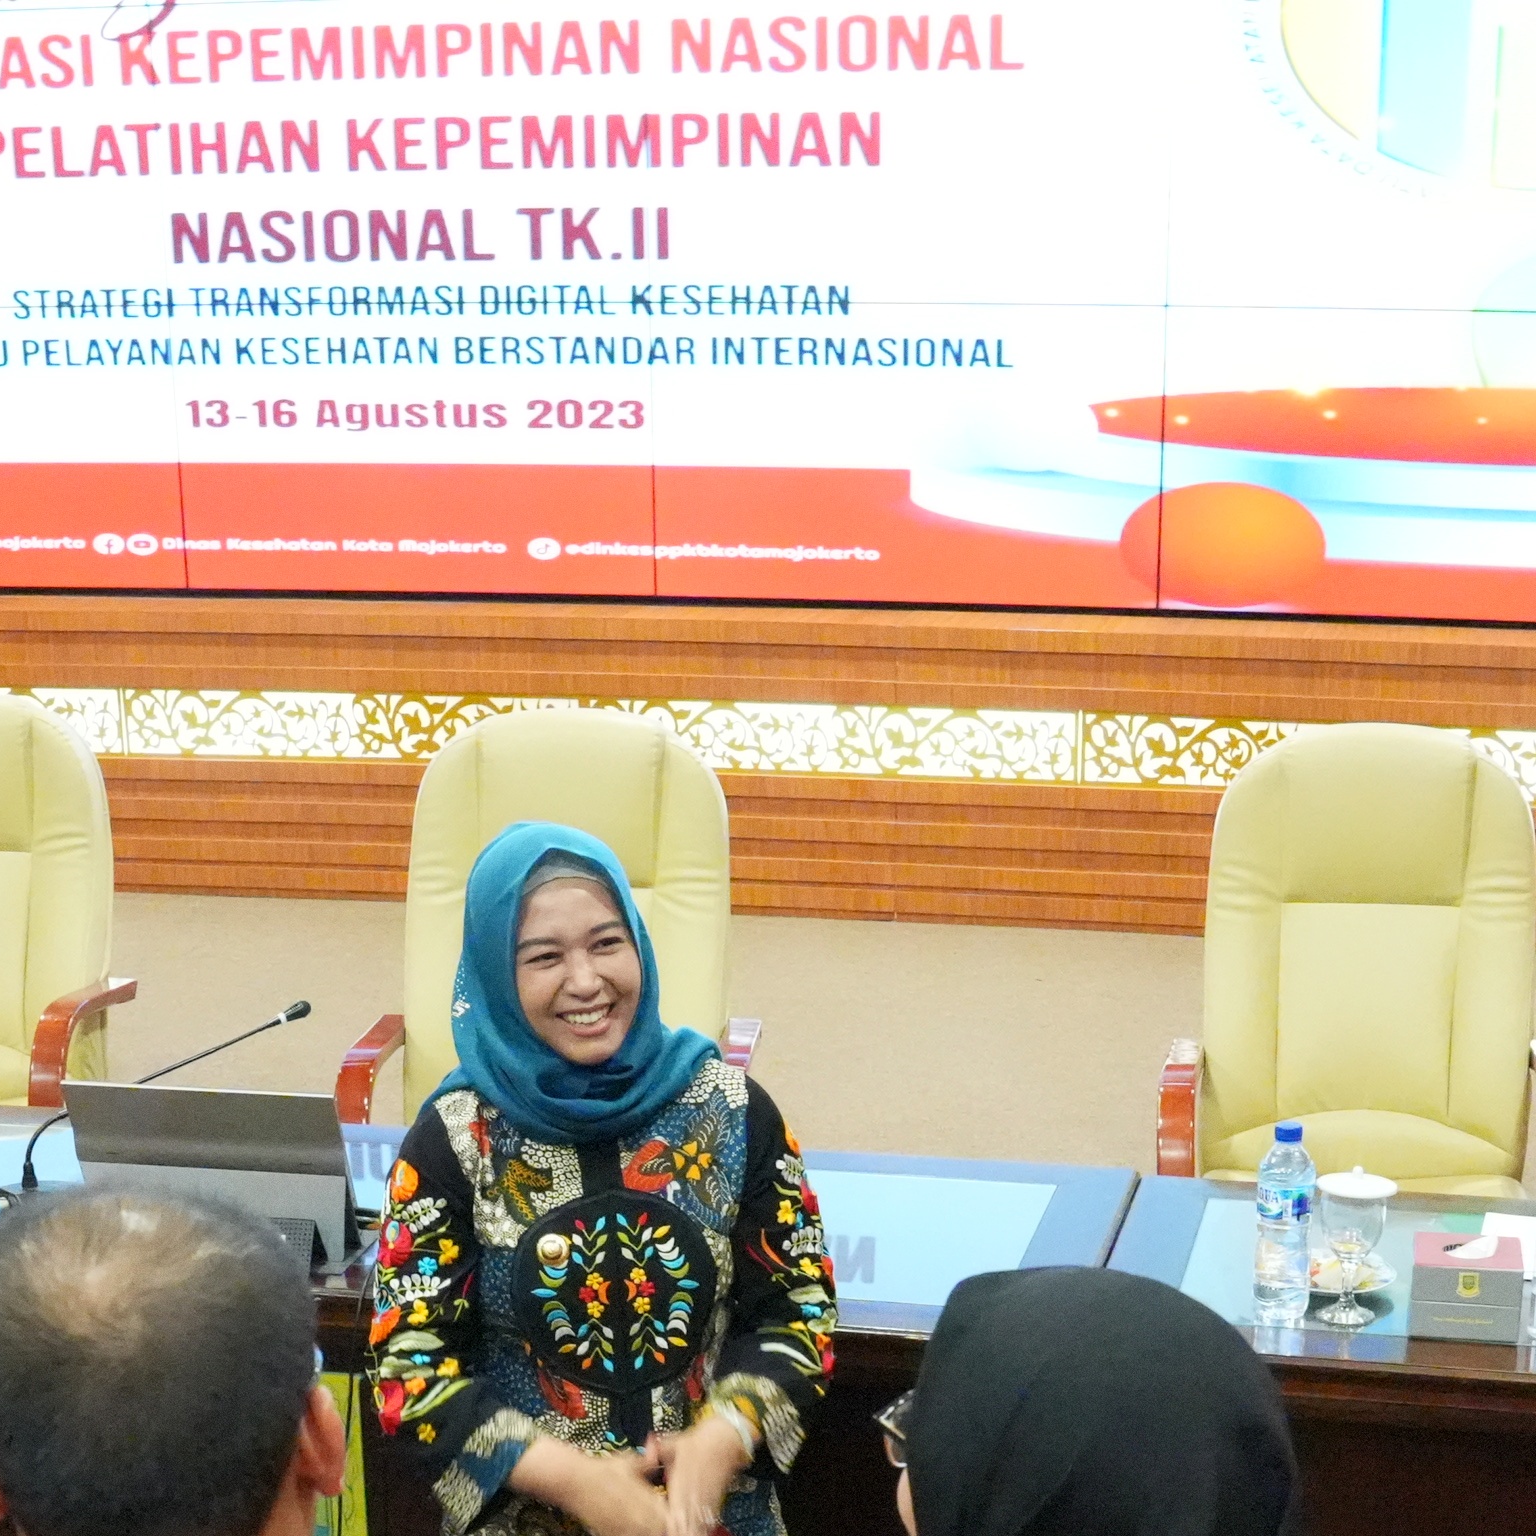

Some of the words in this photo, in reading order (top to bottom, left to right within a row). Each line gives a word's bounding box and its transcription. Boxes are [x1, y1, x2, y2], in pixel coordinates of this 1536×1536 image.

[119, 20, 640, 86] KEPEMIMPINAN
[672, 15, 1023, 72] NASIONAL
[347, 112, 880, 171] KEPEMIMPINAN
[171, 209, 495, 263] NASIONAL
[517, 207, 668, 260] TK.II
[13, 288, 175, 319] STRATEGI
[189, 285, 465, 317] TRANSFORMASI
[479, 285, 615, 315] DIGITAL
[629, 285, 850, 316] KESEHATAN
[22, 338, 221, 366] PELAYANAN
[236, 337, 439, 365] KESEHATAN
[454, 337, 695, 365] BERSTANDAR
[712, 337, 1013, 368] INTERNASIONAL
[188, 400, 297, 427] 13-16
[317, 400, 507, 431] Agustus
[528, 400, 644, 428] 2023
[161, 536, 222, 551] Dinas
[225, 537, 338, 552] Kesehatan
[342, 539, 394, 552] Kota
